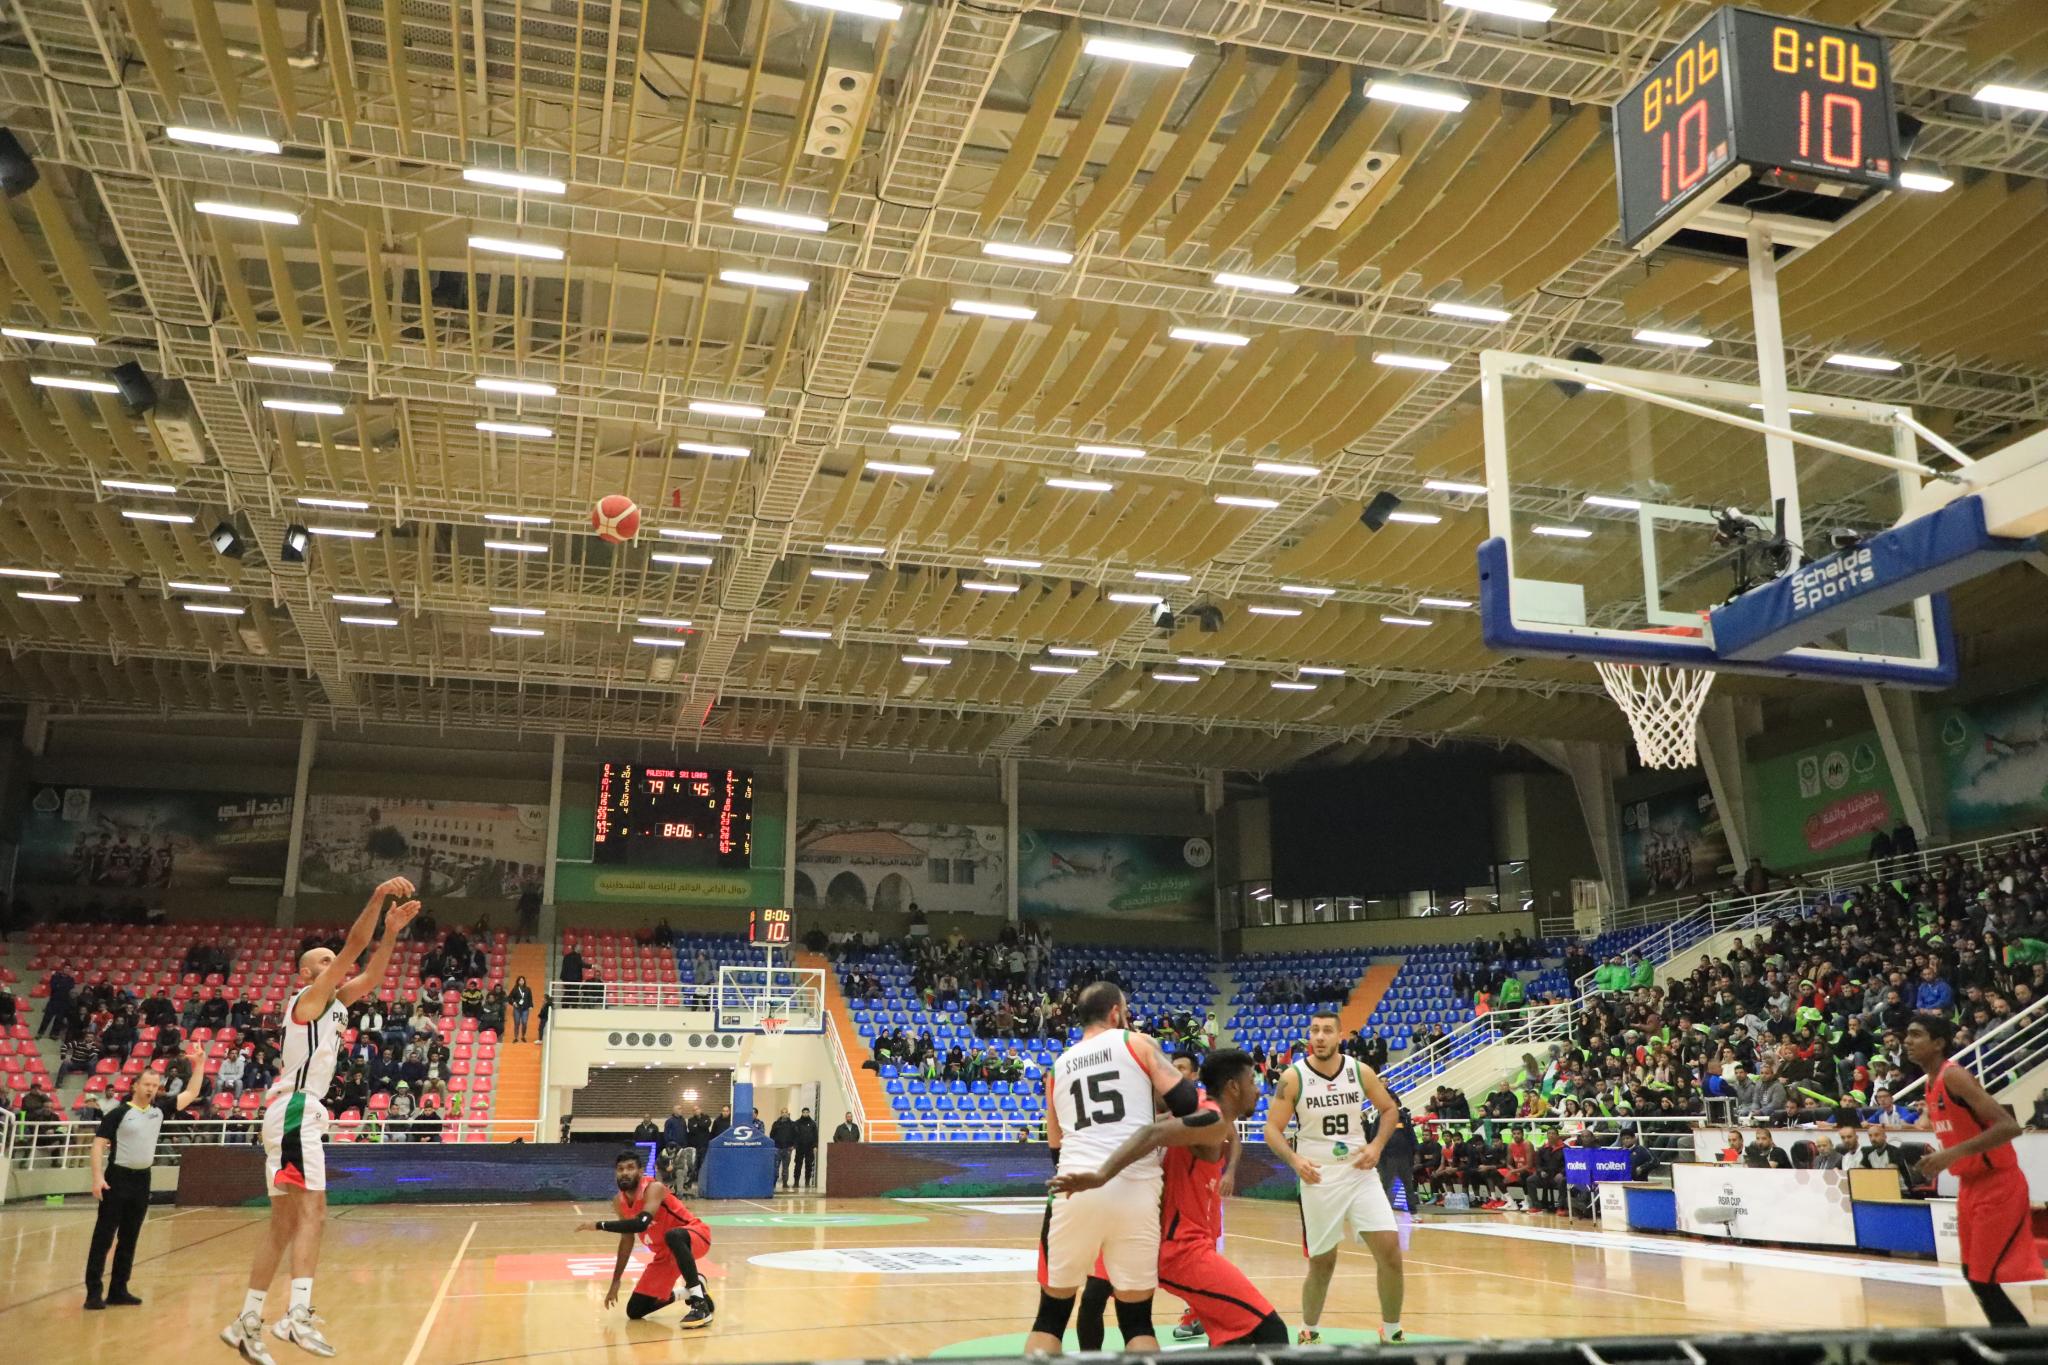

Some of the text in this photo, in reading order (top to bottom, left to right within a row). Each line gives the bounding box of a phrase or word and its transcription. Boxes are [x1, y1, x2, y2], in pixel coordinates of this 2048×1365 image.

[1773, 26, 1878, 90] 8:06
[1643, 40, 1720, 133] 8:06
[1799, 90, 1862, 168] 10
[1660, 98, 1708, 203] 10
[1791, 548, 1872, 594] Schelde
[1793, 566, 1874, 610] Sports
[646, 769, 675, 778] PALESTINE
[649, 780, 664, 793] 79
[673, 783, 680, 793] 4
[693, 783, 709, 796] 45
[709, 800, 715, 808] 0
[664, 824, 692, 837] 8:06
[764, 909, 790, 921] 8:06
[768, 923, 785, 940] 10
[1066, 1061, 1071, 1074] S
[1070, 1070, 1125, 1131] 15
[1306, 1091, 1360, 1109] PALESTINE
[1322, 1113, 1349, 1136] 69
[1596, 1162, 1626, 1170] molten
